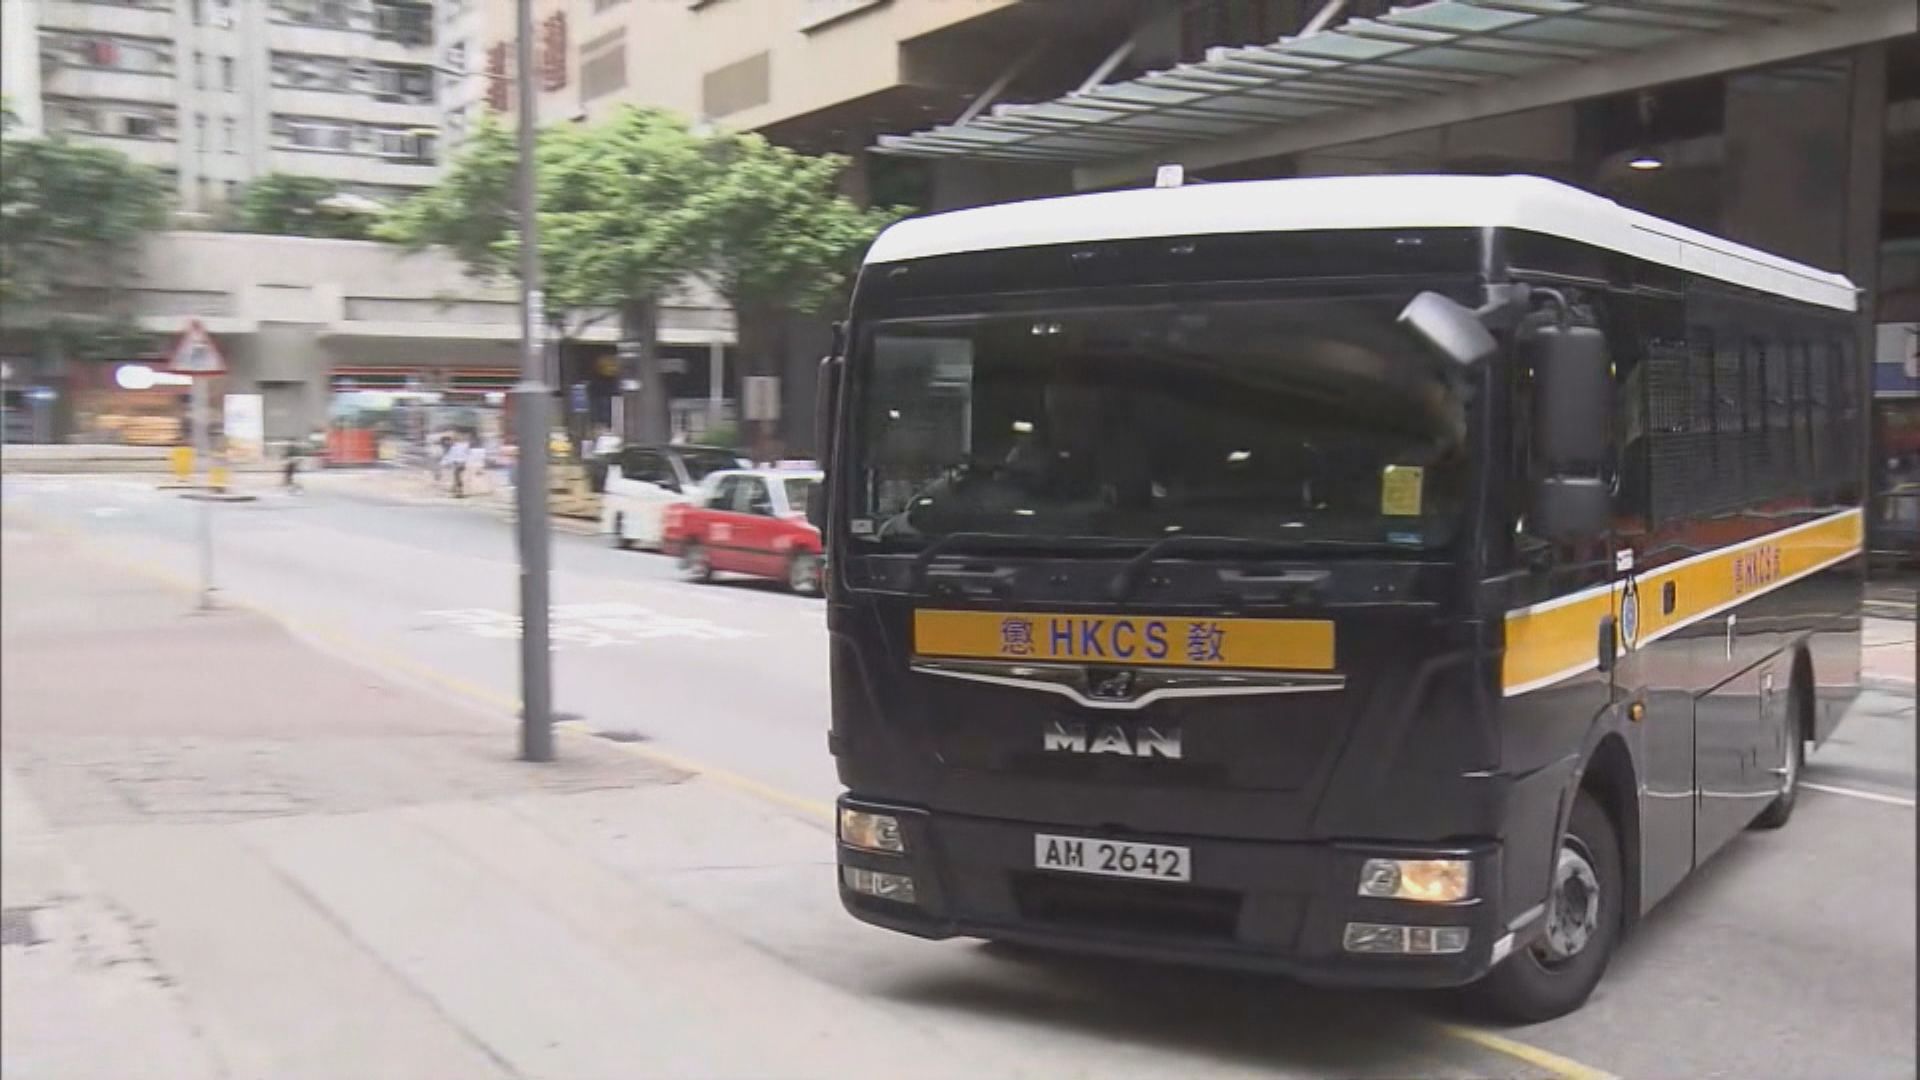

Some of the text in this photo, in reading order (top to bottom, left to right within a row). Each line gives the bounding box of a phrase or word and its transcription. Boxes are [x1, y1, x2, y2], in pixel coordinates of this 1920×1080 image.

[1051, 618, 1168, 660] HKCS
[1044, 721, 1182, 759] MAN
[1045, 839, 1181, 877] AM 2642
